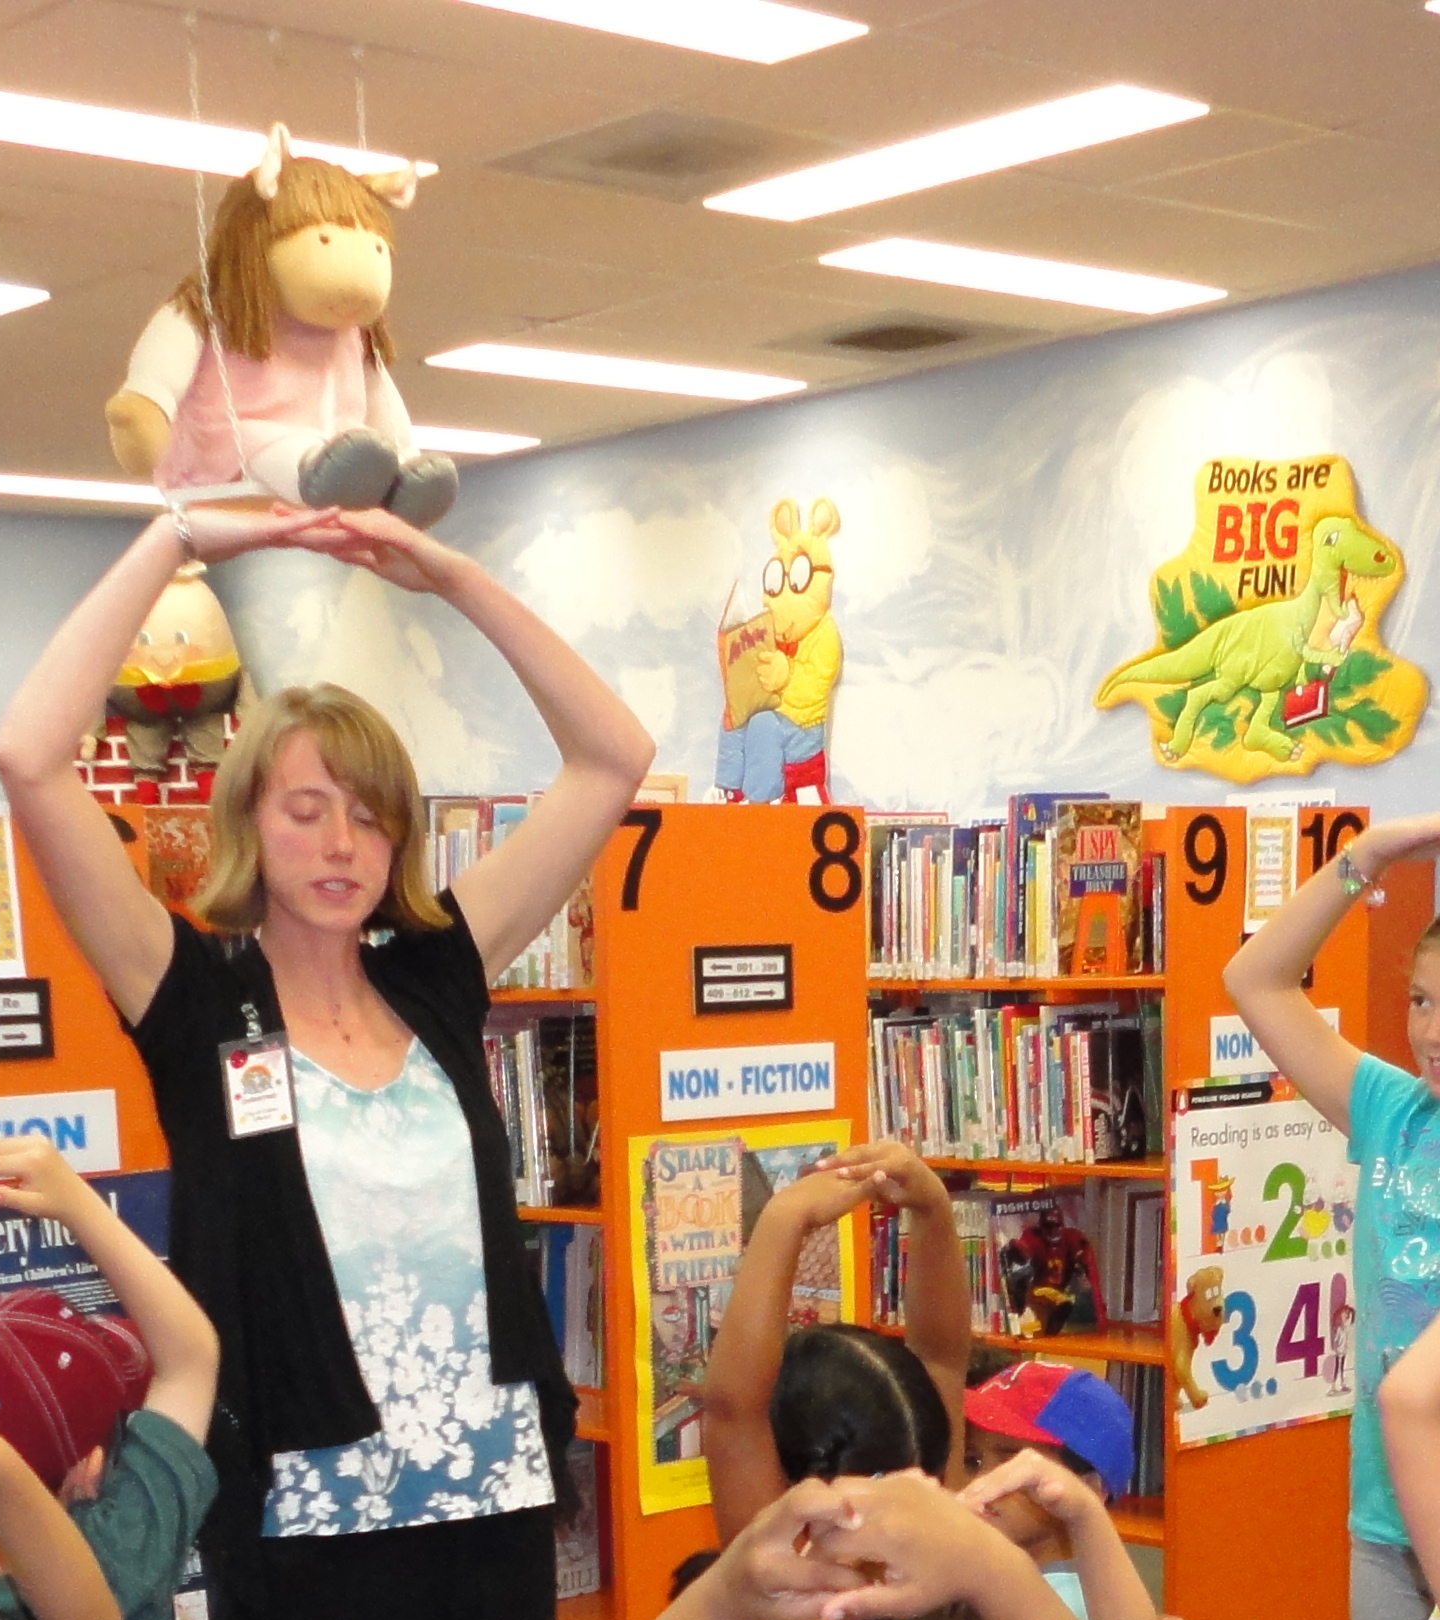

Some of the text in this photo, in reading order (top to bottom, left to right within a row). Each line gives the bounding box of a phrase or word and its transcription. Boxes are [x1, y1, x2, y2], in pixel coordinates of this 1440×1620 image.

[1208, 460, 1330, 494] Books are
[1214, 498, 1300, 563] BIG
[1237, 564, 1296, 600] FUN!
[1079, 829, 1117, 861] I SPY
[1184, 813, 1228, 906] 9
[1301, 811, 1366, 874] 10
[618, 808, 663, 912] 7
[809, 811, 862, 913] 8
[1072, 864, 1125, 881] TREASURE
[1215, 1032, 1254, 1061] NON
[668, 1067, 720, 1101] NON
[740, 1061, 831, 1096] FICTION
[1191, 1119, 1333, 1149] Reading is as easy as
[659, 1148, 736, 1182] SHARE
[693, 1175, 703, 1192] A
[659, 1189, 737, 1232] BOOK
[996, 1200, 1030, 1215] FIGHT
[670, 1231, 731, 1251] WITH A
[23, 1263, 75, 1281] Children's
